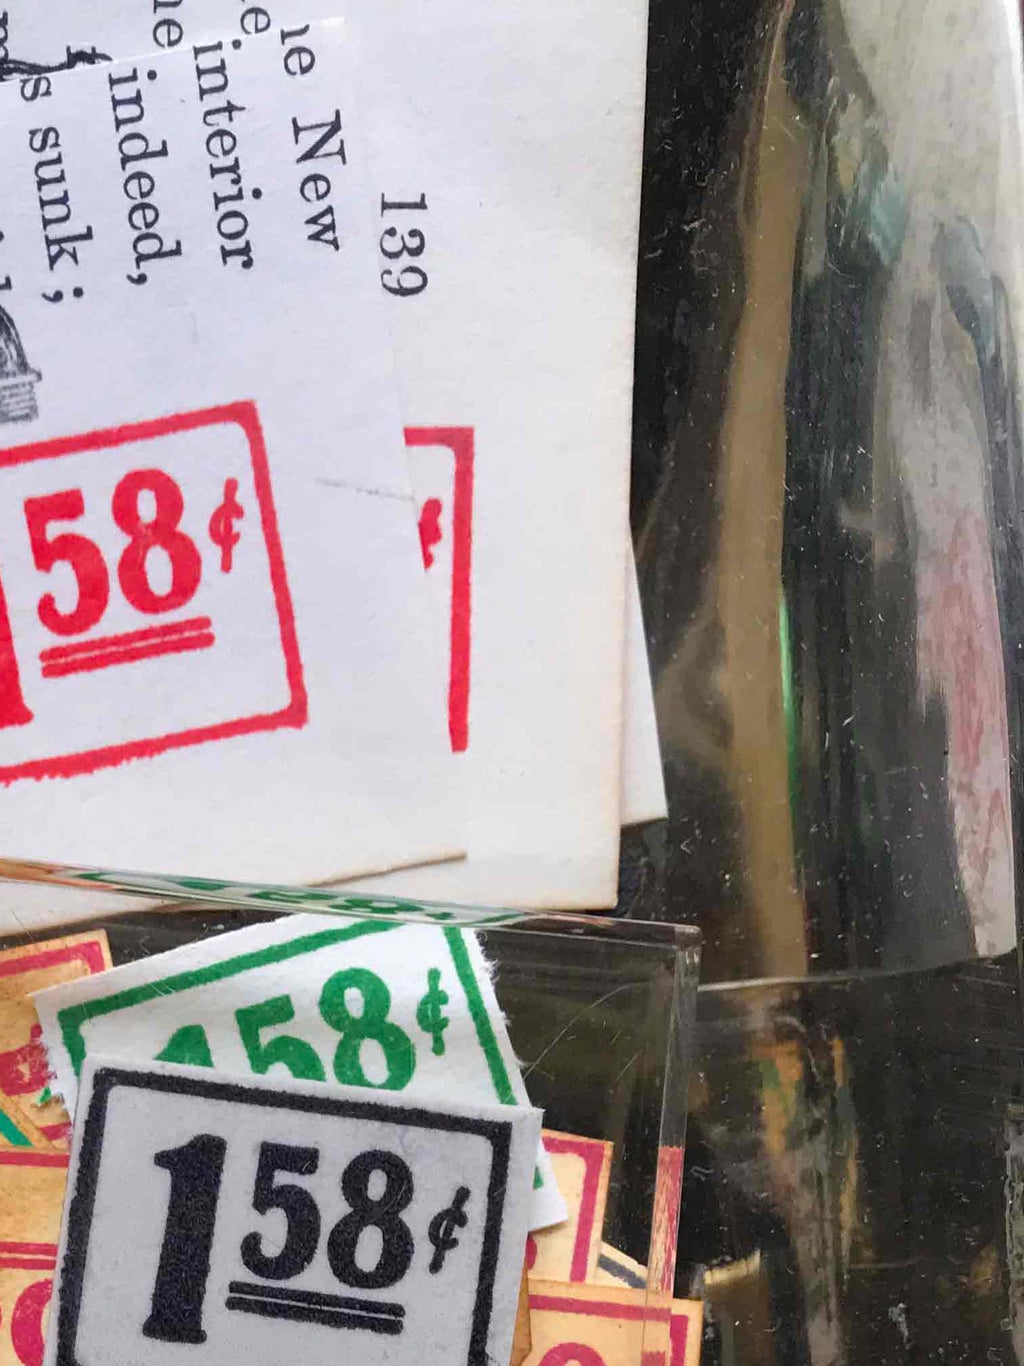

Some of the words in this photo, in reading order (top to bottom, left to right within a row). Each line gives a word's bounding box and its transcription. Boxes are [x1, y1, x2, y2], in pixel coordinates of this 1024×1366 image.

[108, 66, 183, 286] indeed,
[192, 38, 255, 271] interior
[291, 109, 348, 251] New
[379, 192, 429, 297] 139
[154, 966, 450, 1092] 58¢
[142, 1132, 471, 1344] 158¢
